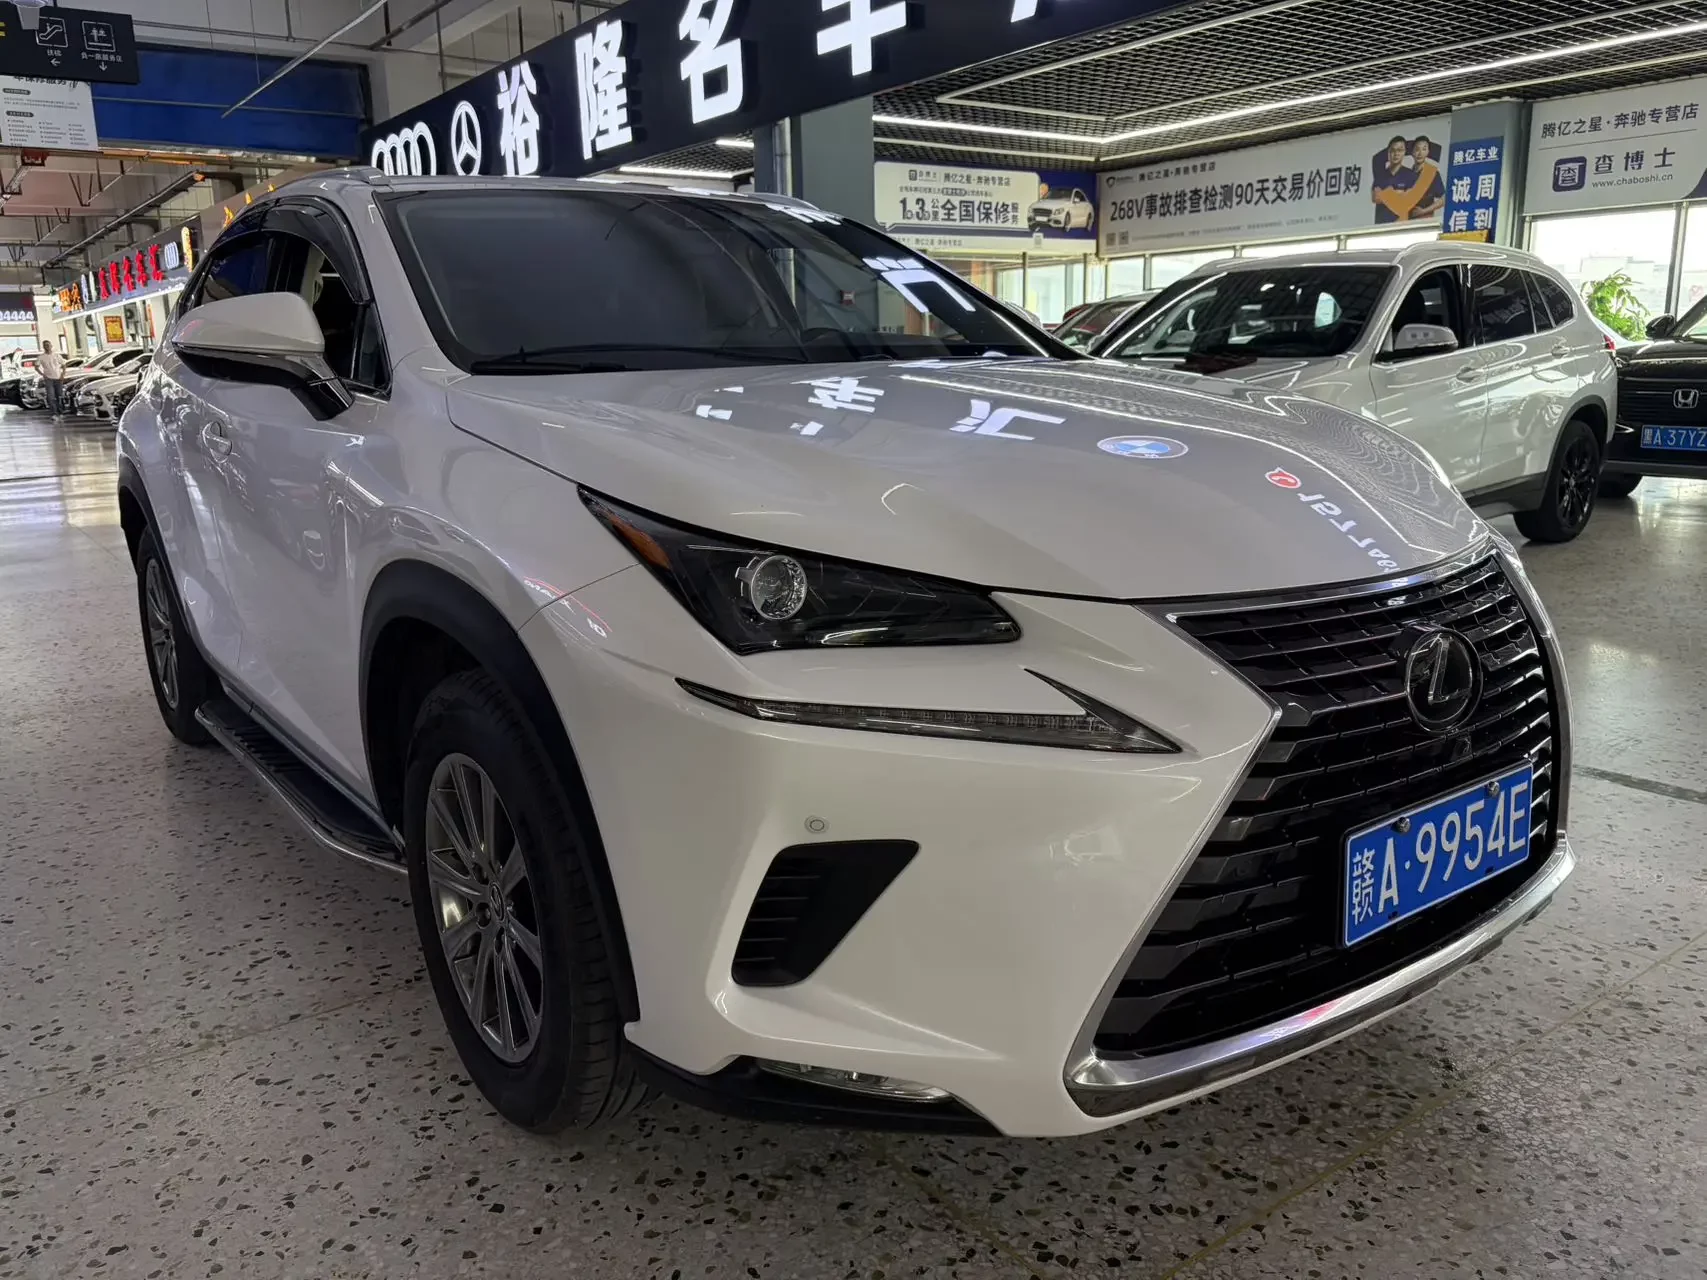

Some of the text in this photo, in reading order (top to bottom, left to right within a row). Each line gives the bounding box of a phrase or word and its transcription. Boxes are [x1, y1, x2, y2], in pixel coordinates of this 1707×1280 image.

[1541, 102, 1700, 139] 腾亿之星·奔驰专营店
[1453, 146, 1499, 164] 腾亿车业
[1593, 147, 1676, 175] 查博士
[1110, 163, 1362, 222] 268V事故排查检测90天交易价回购
[1592, 173, 1674, 188] www.chaboshi.cn
[1351, 780, 1529, 925] 赣A·9954E
